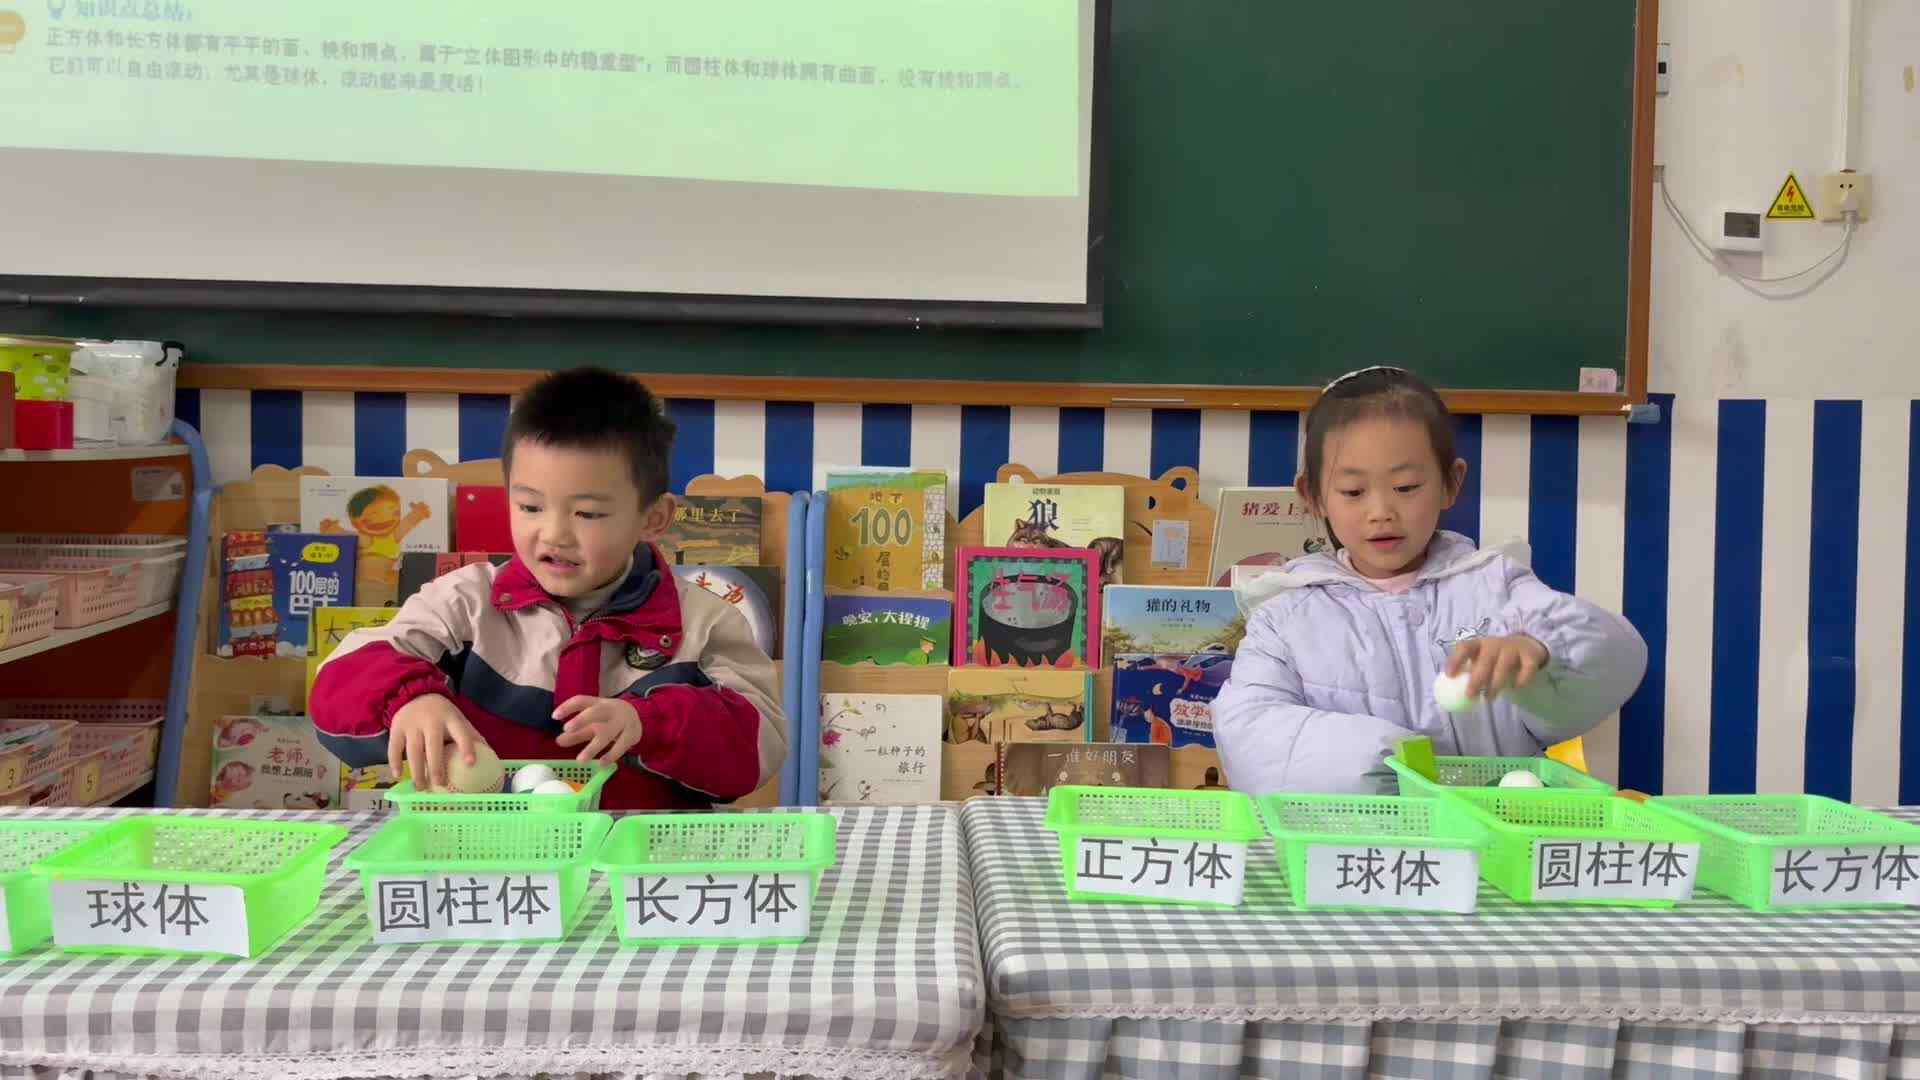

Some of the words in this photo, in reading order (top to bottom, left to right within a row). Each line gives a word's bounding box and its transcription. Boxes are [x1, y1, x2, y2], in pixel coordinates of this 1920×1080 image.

[849, 507, 913, 546] 100
[1027, 498, 1060, 531] 狼
[288, 569, 340, 595] 100层的
[1146, 598, 1211, 614] 獾的礼物
[864, 745, 926, 757] 一粒种子的
[898, 761, 926, 775] 旅行
[1076, 837, 1233, 890] 正方体
[1336, 847, 1441, 896] 球体
[1539, 841, 1689, 890] 圆柱体
[1774, 844, 1920, 895] 长方体
[86, 882, 209, 936] 球体
[378, 875, 551, 933] 圆柱体
[626, 872, 799, 925] 长方体
